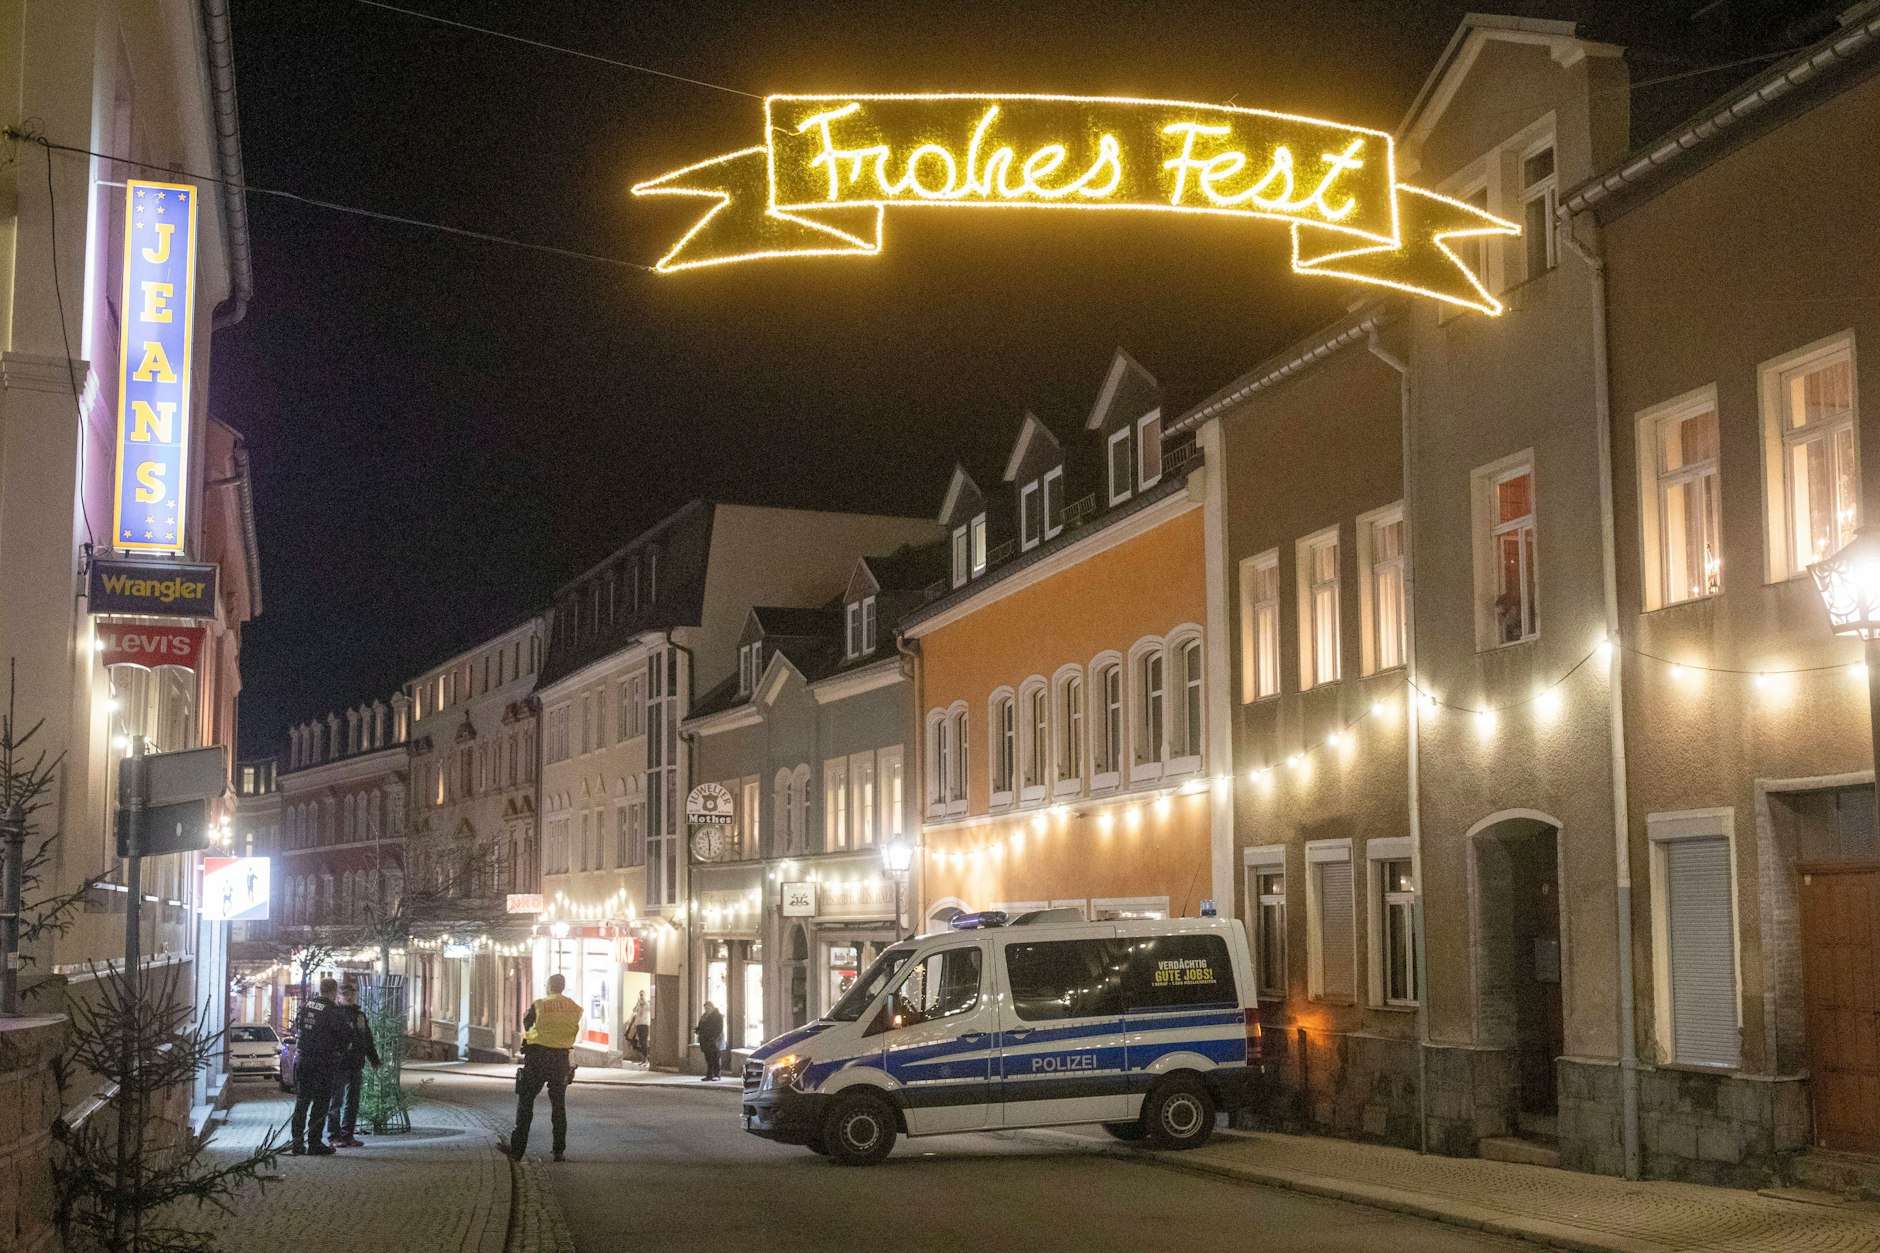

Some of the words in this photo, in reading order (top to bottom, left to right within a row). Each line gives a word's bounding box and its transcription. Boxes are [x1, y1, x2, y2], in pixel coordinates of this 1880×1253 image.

[798, 103, 1120, 200] Frohes
[1162, 121, 1363, 219] Fest
[130, 222, 177, 504] JEANS
[101, 573, 206, 602] Wrangler
[688, 784, 732, 806] JUWELIER
[688, 813, 732, 824] Mothes
[1155, 970, 1181, 981] GUTE
[1184, 968, 1213, 980] JOBS!
[1158, 959, 1207, 970] VERDÄCHTIG
[1032, 1054, 1097, 1072] POLIZEI
